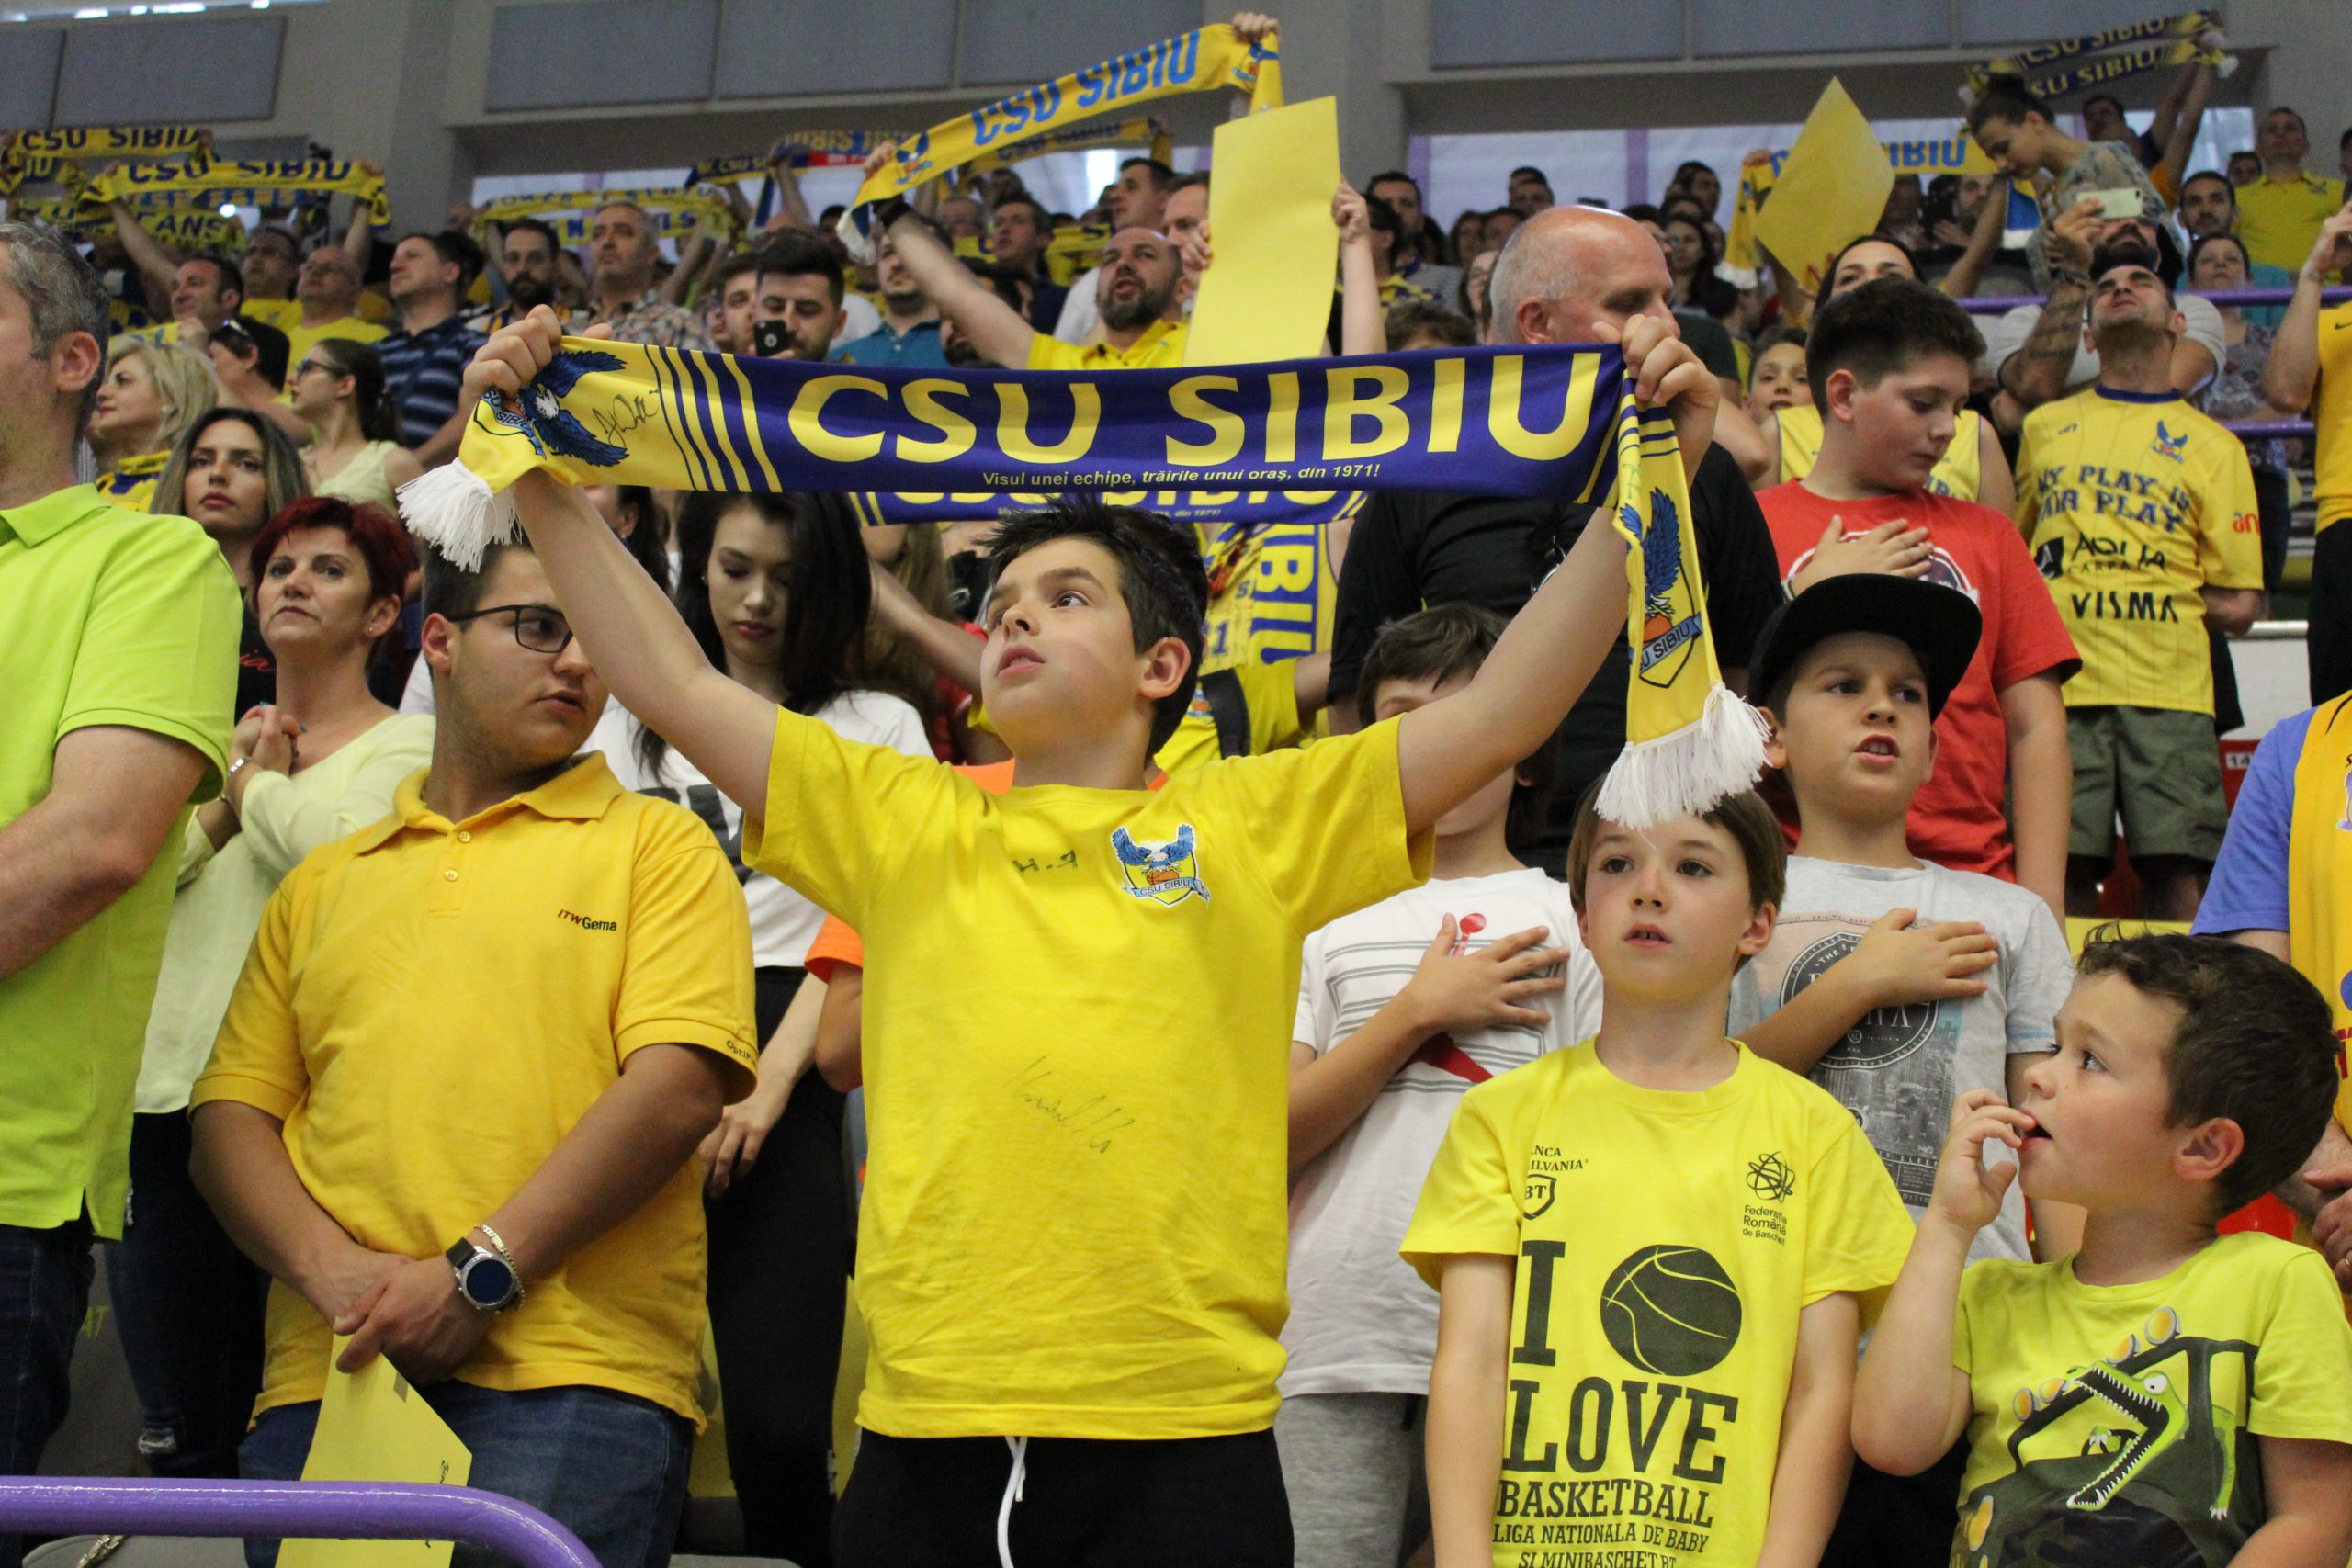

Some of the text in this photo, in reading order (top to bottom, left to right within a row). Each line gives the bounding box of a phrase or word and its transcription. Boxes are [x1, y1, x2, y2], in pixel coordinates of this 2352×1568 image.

[970, 80, 1063, 146] CSU
[1076, 29, 1200, 108] SIBIU
[2030, 48, 2156, 98] SU SIBIU
[21, 128, 200, 151] CSU SIBIU
[1888, 140, 1967, 168] IBIU
[129, 161, 209, 183] CSU
[481, 389, 502, 407] SU
[787, 352, 1602, 467] CSU SIBIU
[983, 471, 1025, 486] Visul
[1031, 471, 1069, 486] unei
[1073, 469, 1136, 488] echipe,
[1142, 468, 1199, 483] trăirile
[1204, 468, 1244, 481] unui
[1298, 467, 1326, 479] din
[1333, 463, 1381, 478] 1971!
[2078, 465, 2158, 496] PLAY
[2039, 488, 2183, 533] AIR PLAY
[2071, 591, 2179, 624] VISMA
[1654, 622, 1691, 660] SIBIU
[1140, 878, 1191, 896] CSU SIBIU
[1817, 950, 1839, 964] THE
[1532, 1145, 1562, 1157] NCA
[1524, 1184, 1547, 1200] BT
[1742, 1227, 1753, 1237] de
[1512, 1240, 1566, 1367] I
[1502, 1375, 1738, 1485] LOVE
[1497, 1478, 1713, 1528] BASKETBALL
[1492, 1522, 1710, 1553] LIGA NATIONALA DE BABY
[1518, 1551, 1538, 1568] SI
[1541, 1550, 1657, 1568] MINIBASCHET
